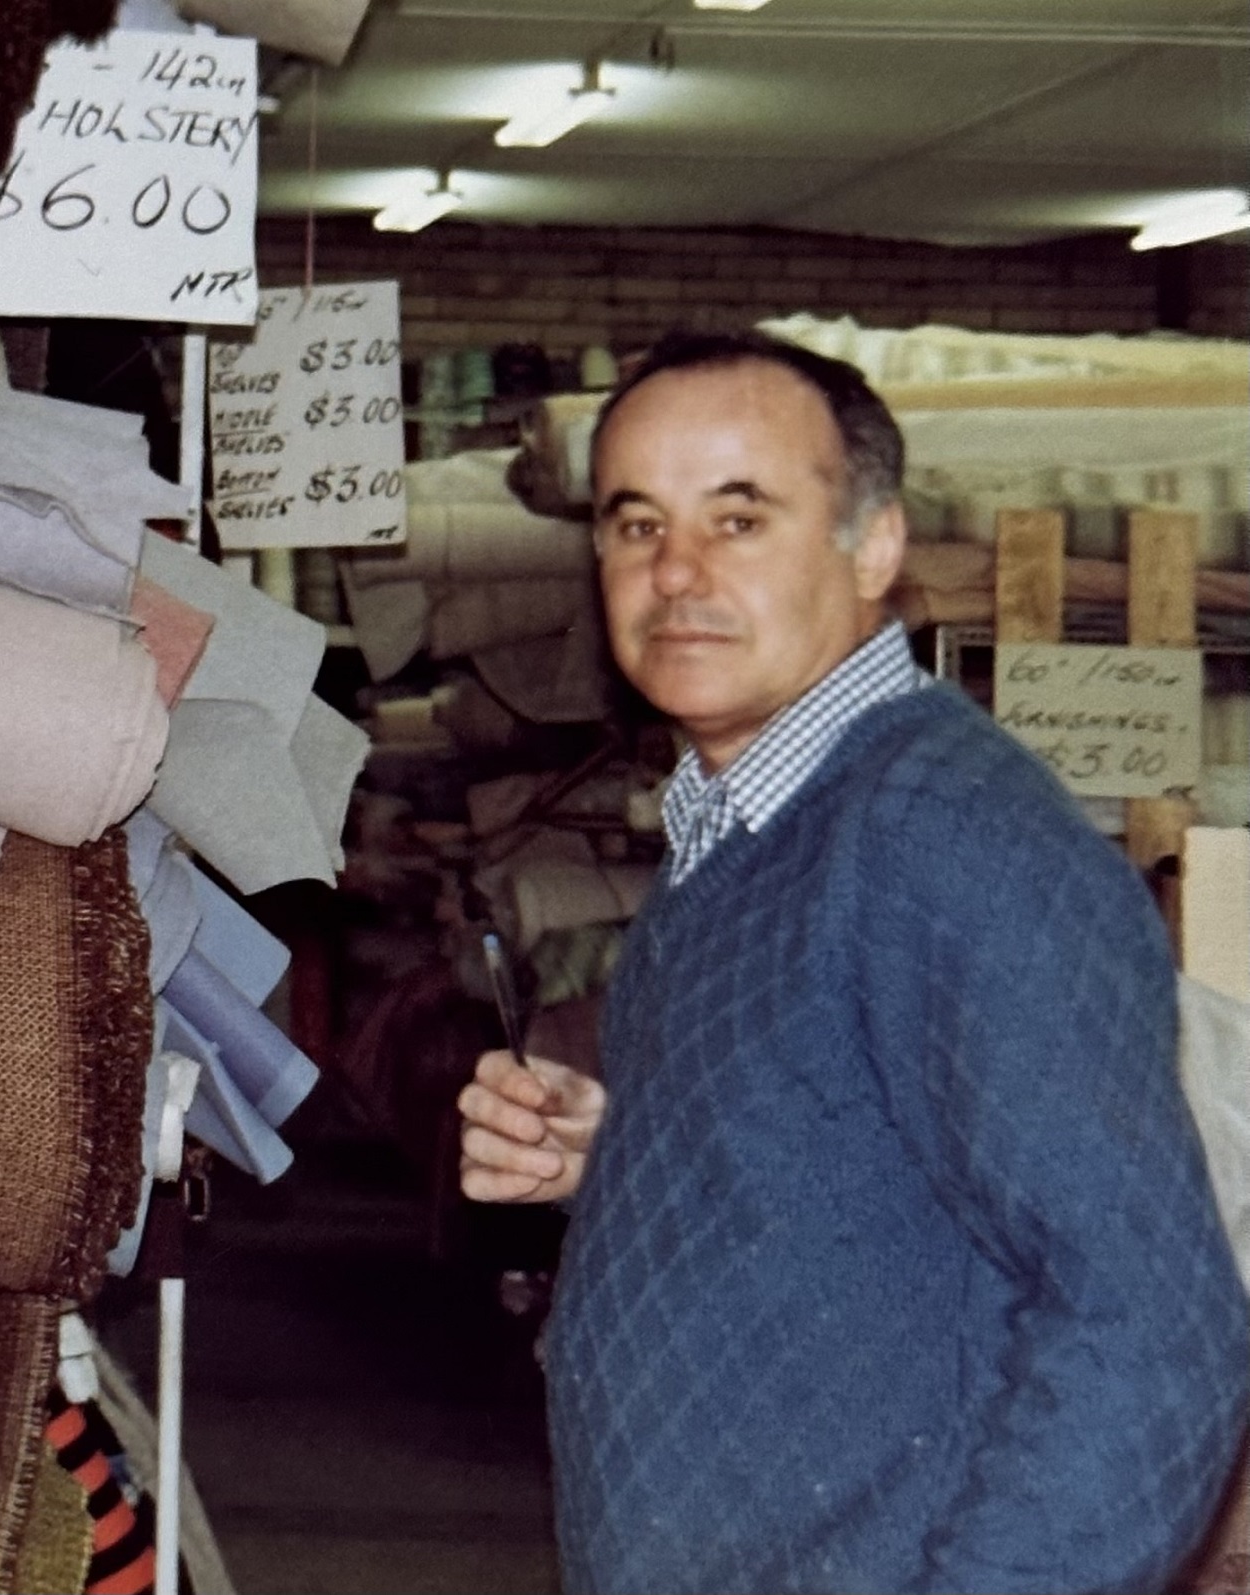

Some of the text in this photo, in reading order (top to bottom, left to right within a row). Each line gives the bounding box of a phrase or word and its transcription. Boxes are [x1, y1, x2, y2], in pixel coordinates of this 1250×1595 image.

[38, 99, 259, 166] HOLSTERY
[300, 339, 400, 375] $3.00
[304, 391, 401, 429] $3.00
[305, 464, 402, 506] $3.00
